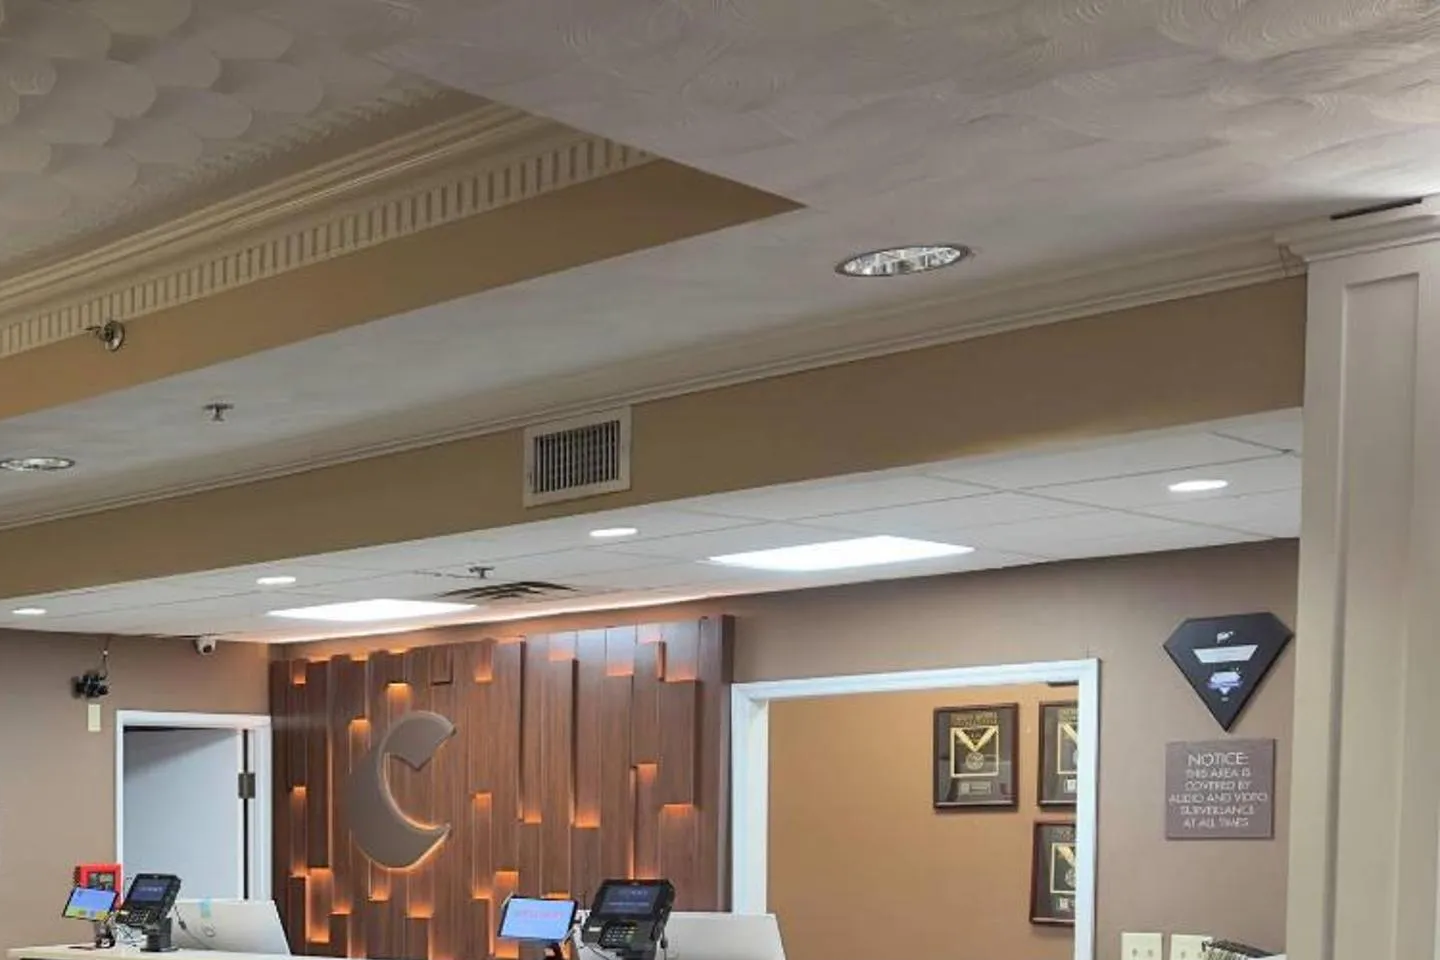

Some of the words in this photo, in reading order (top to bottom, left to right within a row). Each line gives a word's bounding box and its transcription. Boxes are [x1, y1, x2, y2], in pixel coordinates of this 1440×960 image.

[1211, 767, 1238, 778] AREA
[1241, 767, 1252, 777] IS
[1184, 781, 1236, 791] COVERED
[1238, 780, 1252, 790] BY
[1168, 793, 1205, 804] AUDIO
[1207, 792, 1232, 803] AND
[1234, 791, 1268, 802] VIDEO
